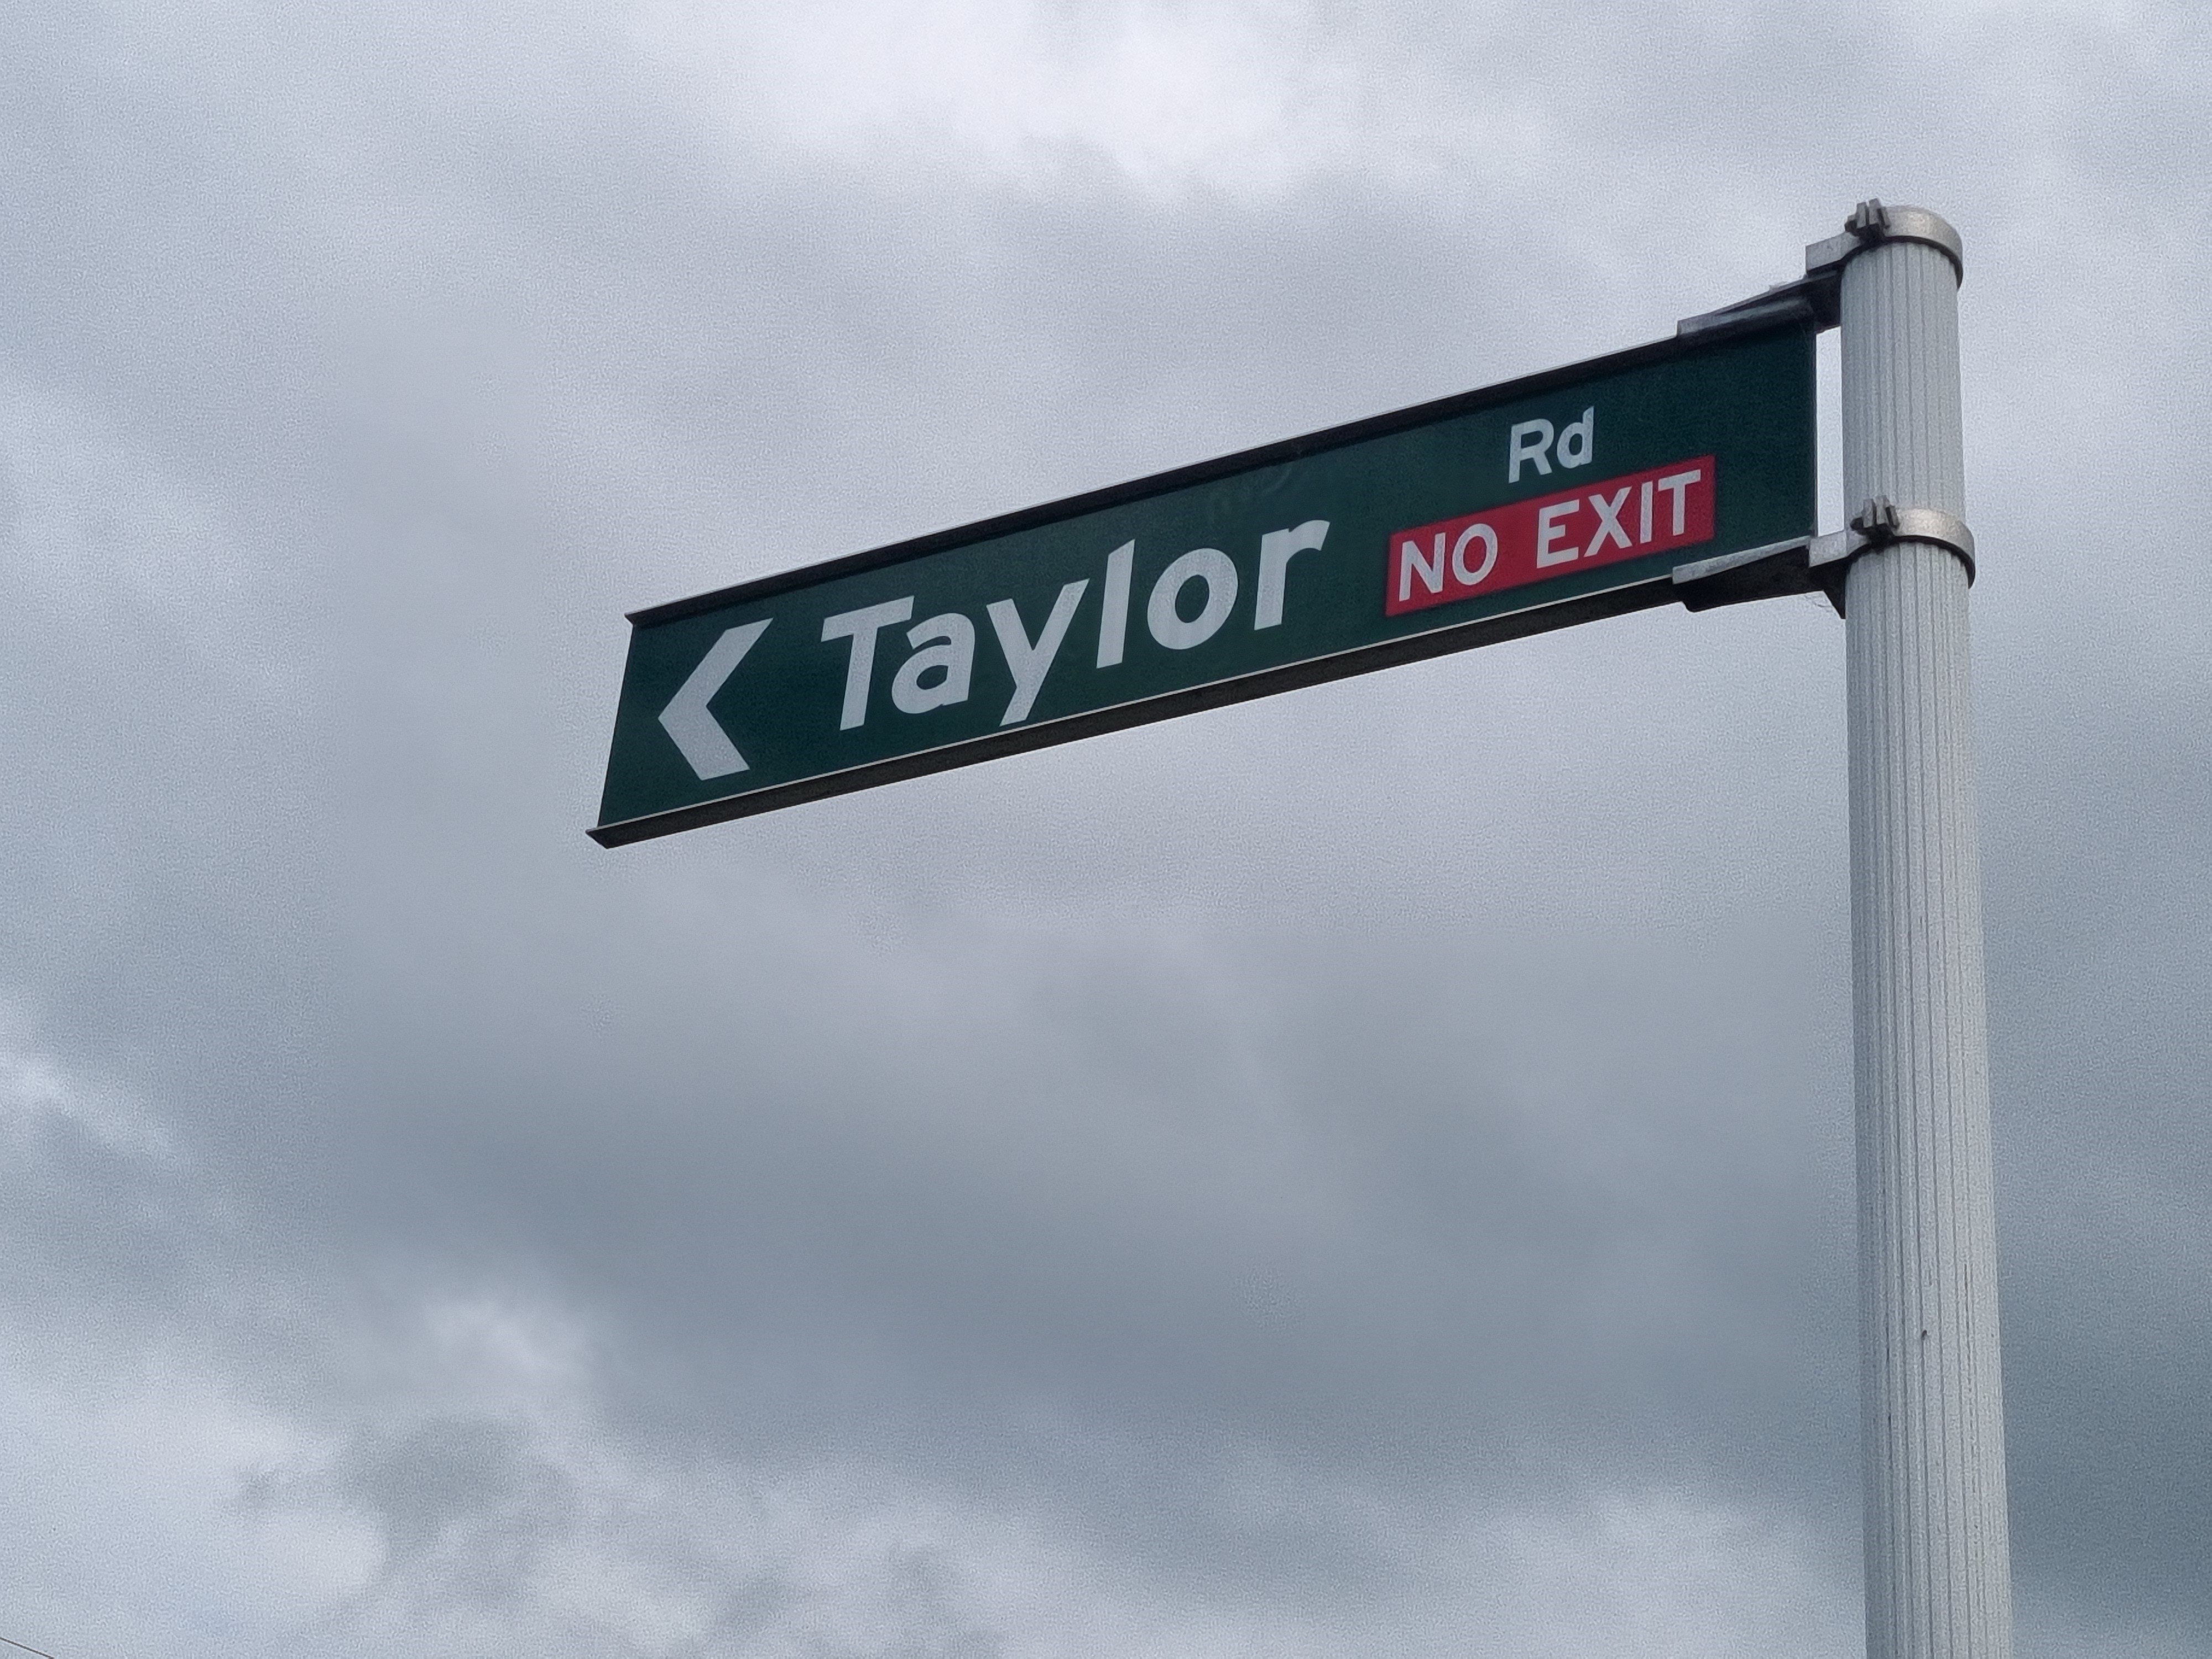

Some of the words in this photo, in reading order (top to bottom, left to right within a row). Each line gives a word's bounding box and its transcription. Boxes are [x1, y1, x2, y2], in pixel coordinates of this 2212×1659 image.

[1508, 406, 1594, 483] Rd
[1399, 523, 1499, 602] NO
[1536, 469, 1702, 569] EXIT
[821, 520, 1331, 731] Taylor
